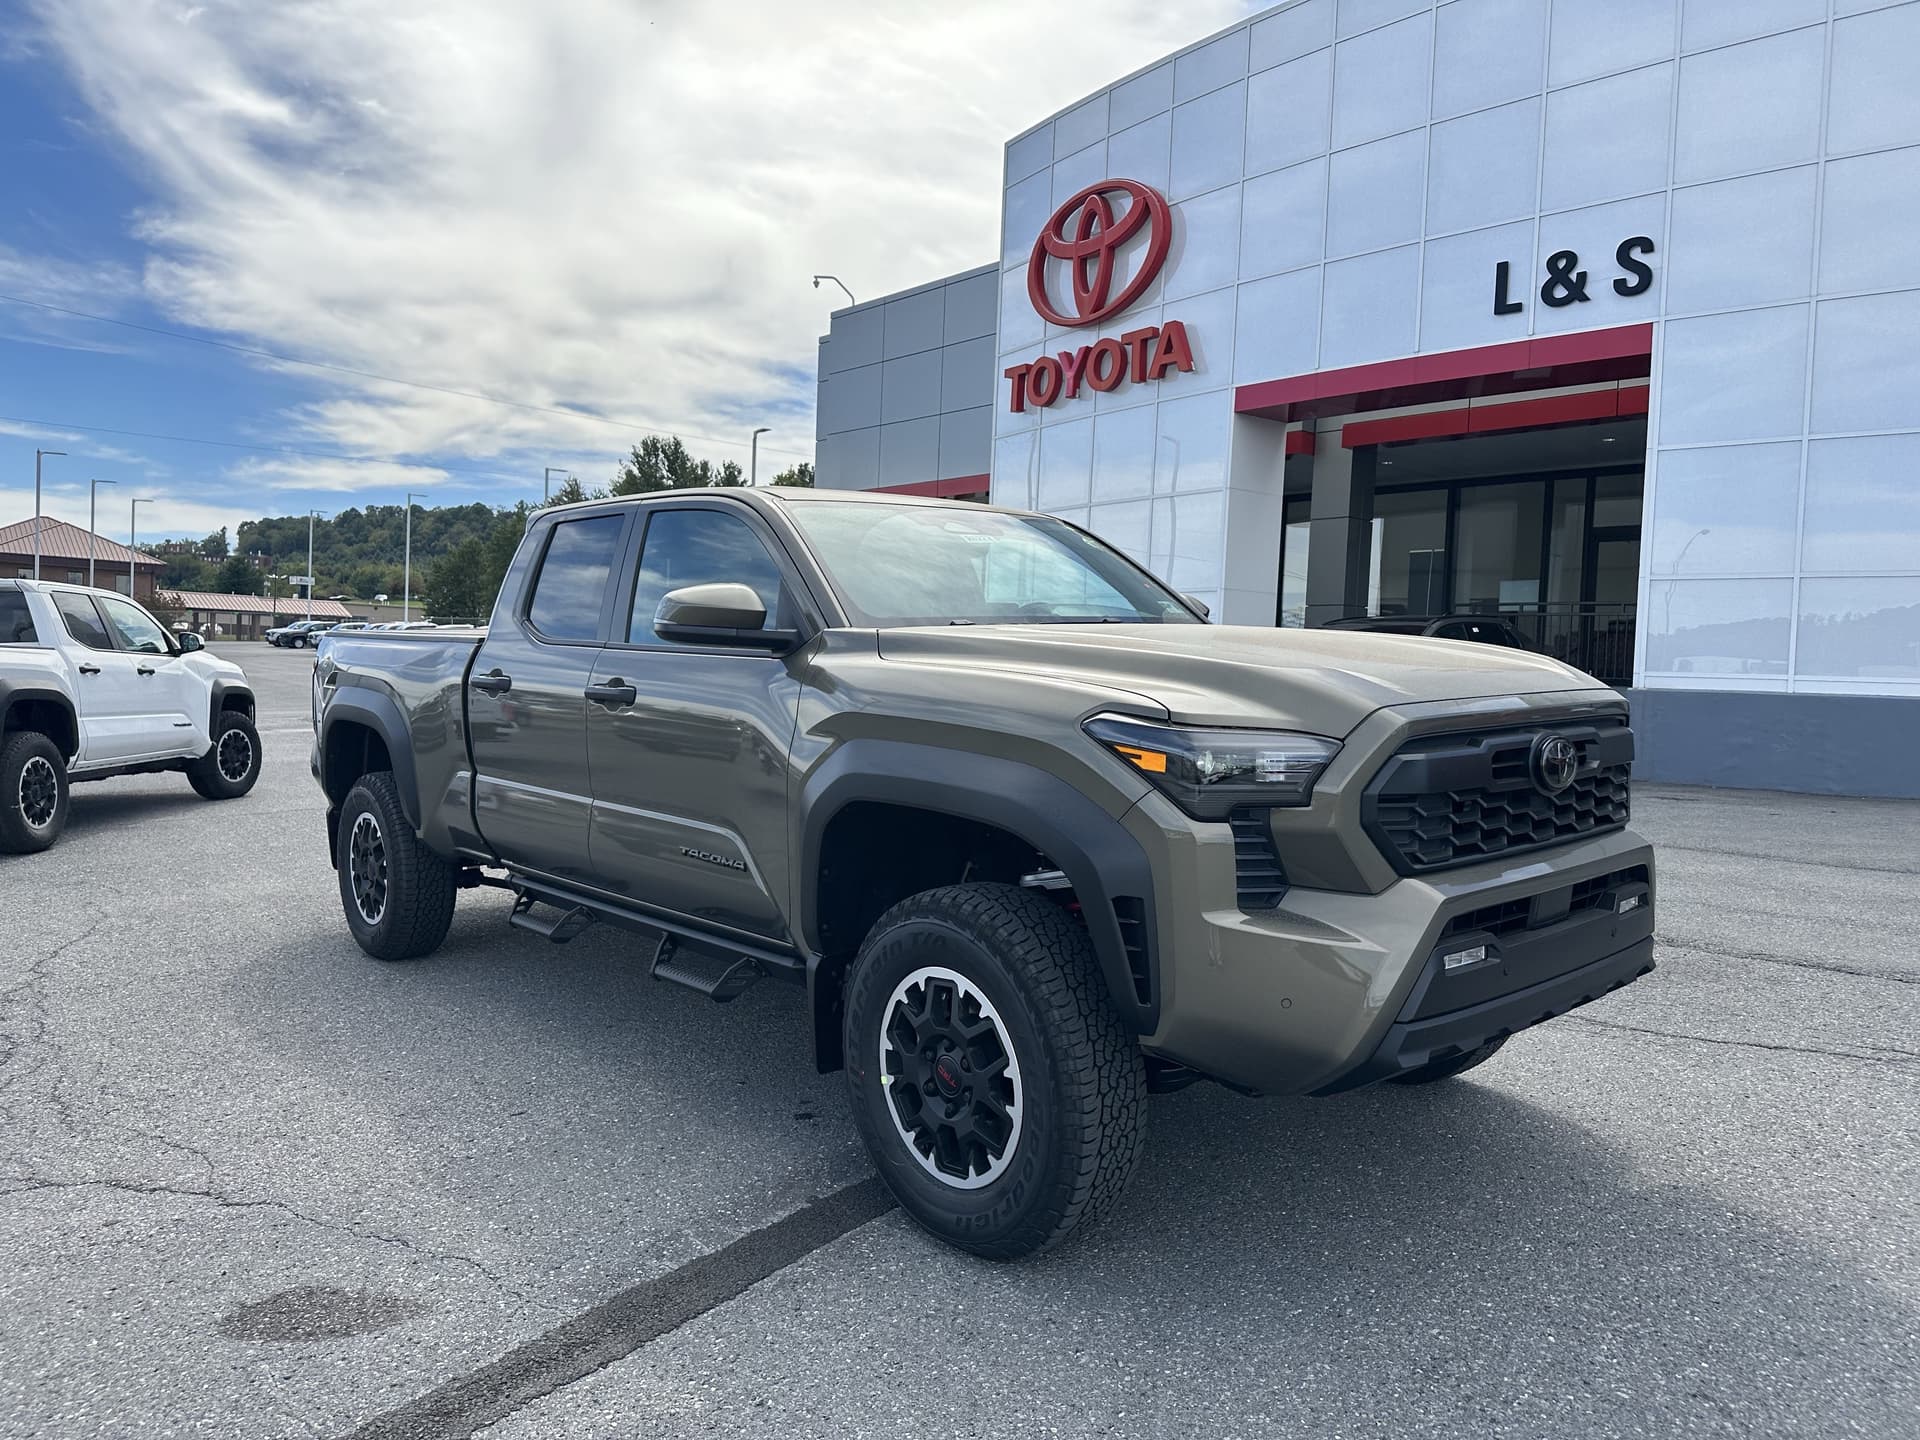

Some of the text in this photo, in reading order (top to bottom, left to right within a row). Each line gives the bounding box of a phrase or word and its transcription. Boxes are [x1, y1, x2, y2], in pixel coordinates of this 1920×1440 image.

[1494, 236, 1655, 315] L & S
[1005, 320, 1194, 412] TOYOTA
[680, 846, 745, 870] TACOMA
